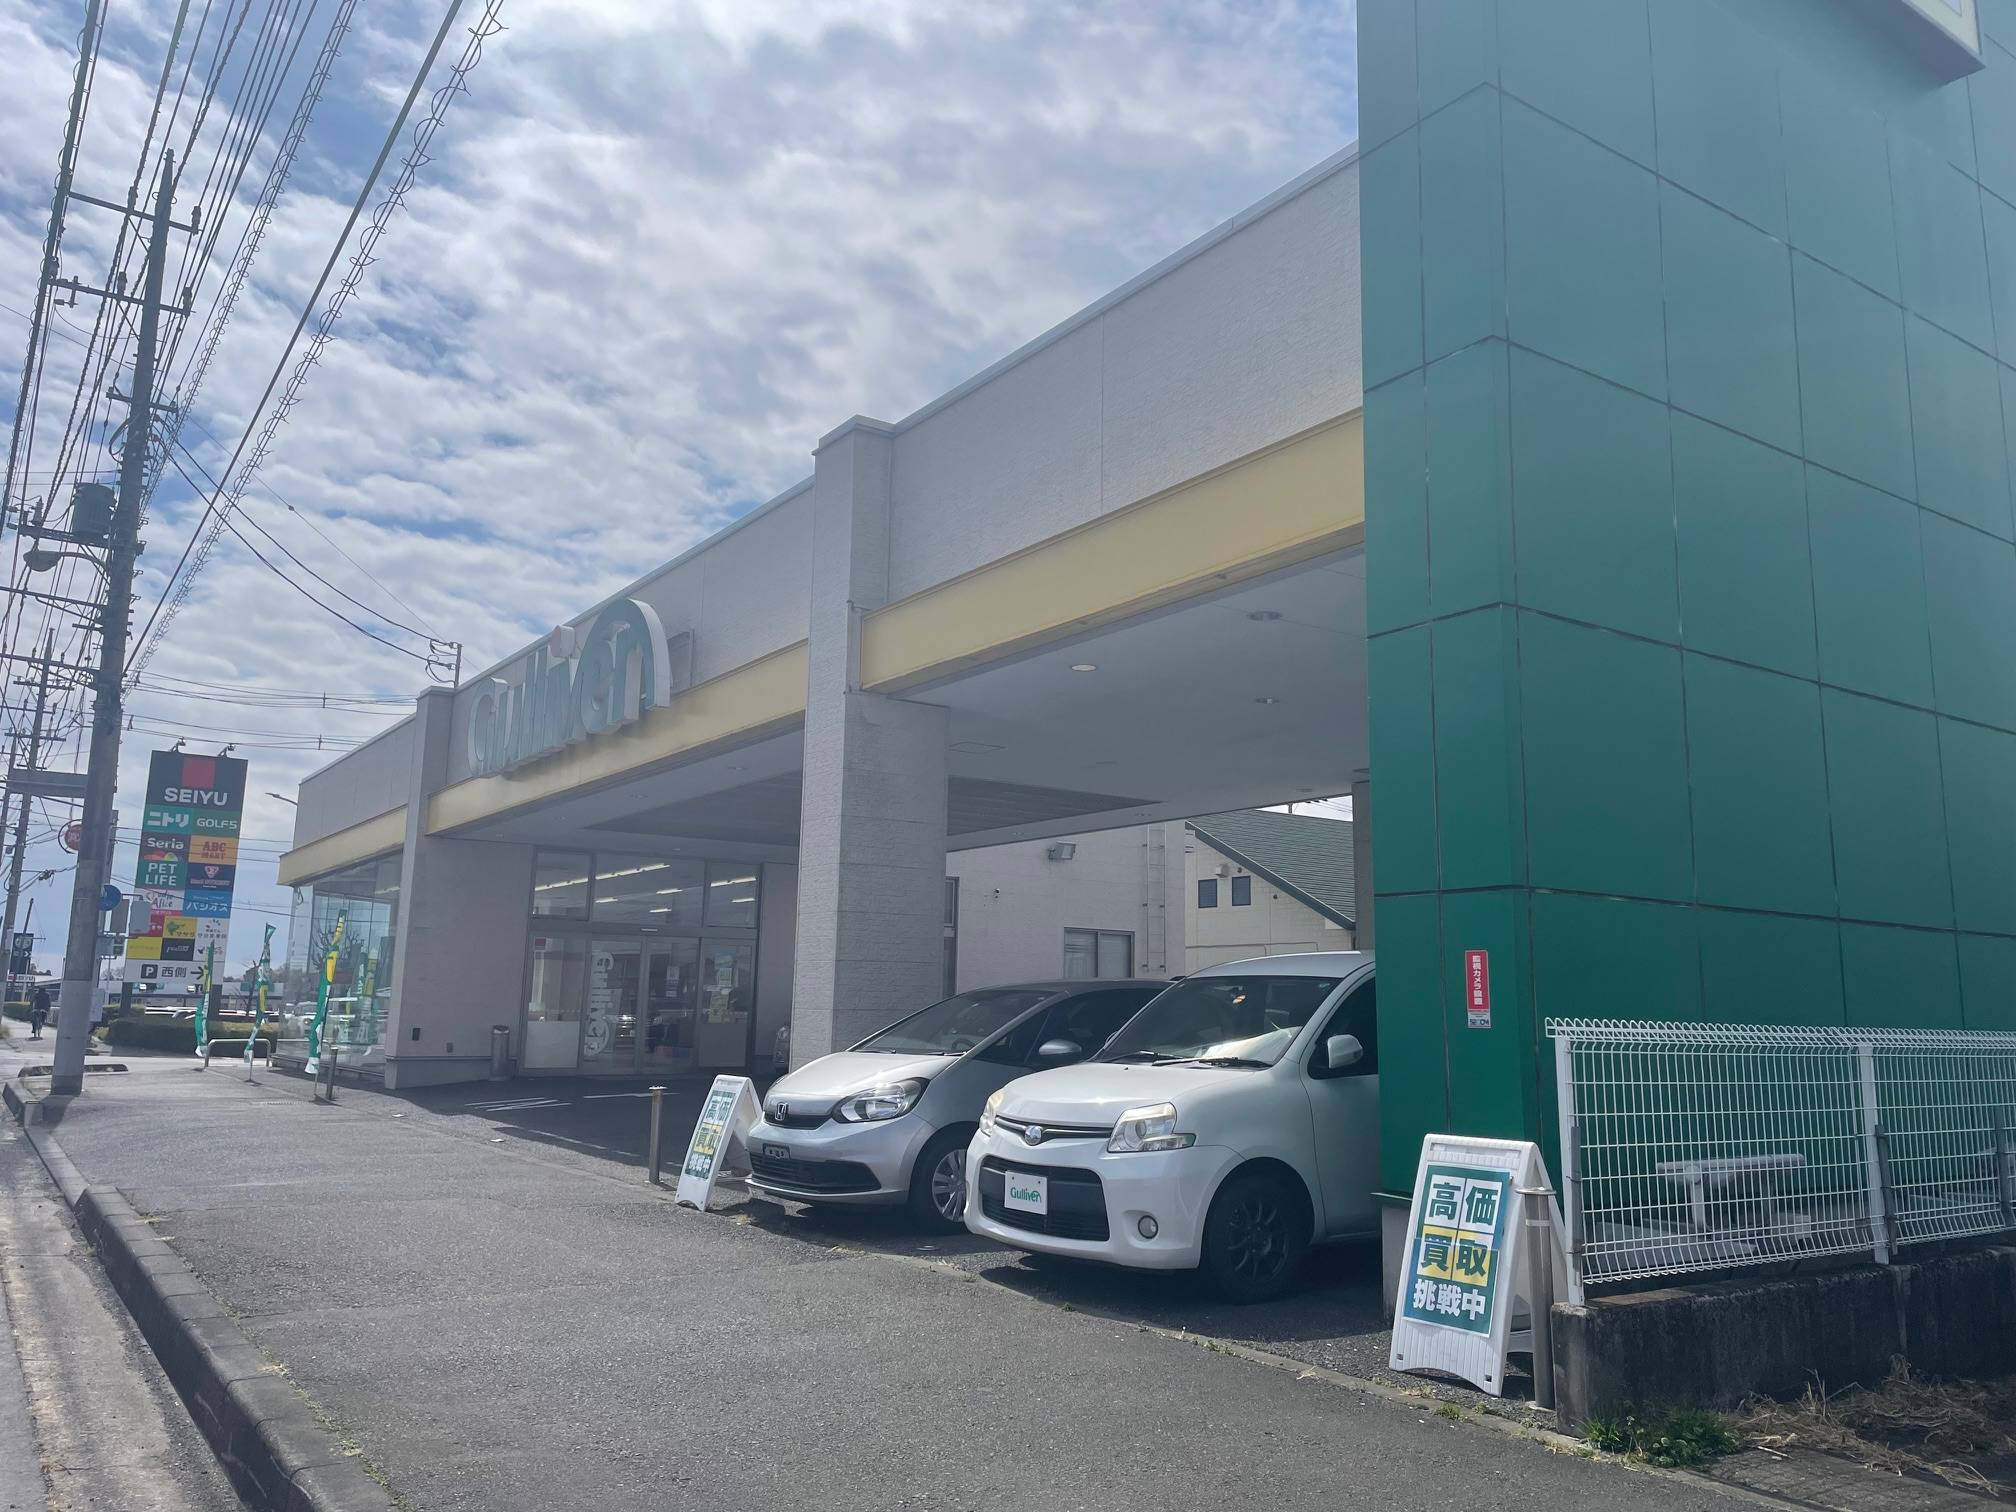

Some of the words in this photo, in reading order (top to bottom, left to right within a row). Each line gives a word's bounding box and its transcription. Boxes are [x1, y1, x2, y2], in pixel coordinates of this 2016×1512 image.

[164, 787, 228, 806] SEIYU
[147, 811, 190, 828] ニトリ
[196, 818, 238, 830] GOLF5
[147, 837, 185, 850] Seria
[203, 841, 227, 852] ABC
[148, 862, 177, 874] PET
[145, 874, 177, 886] LIFE
[145, 967, 154, 976] P
[161, 966, 187, 978] 西側
[1010, 1187, 1042, 1203] Gulliver
[1428, 1182, 1500, 1227] 高価
[1420, 1233, 1488, 1278] 買取
[1413, 1278, 1486, 1321] 挑戦中
